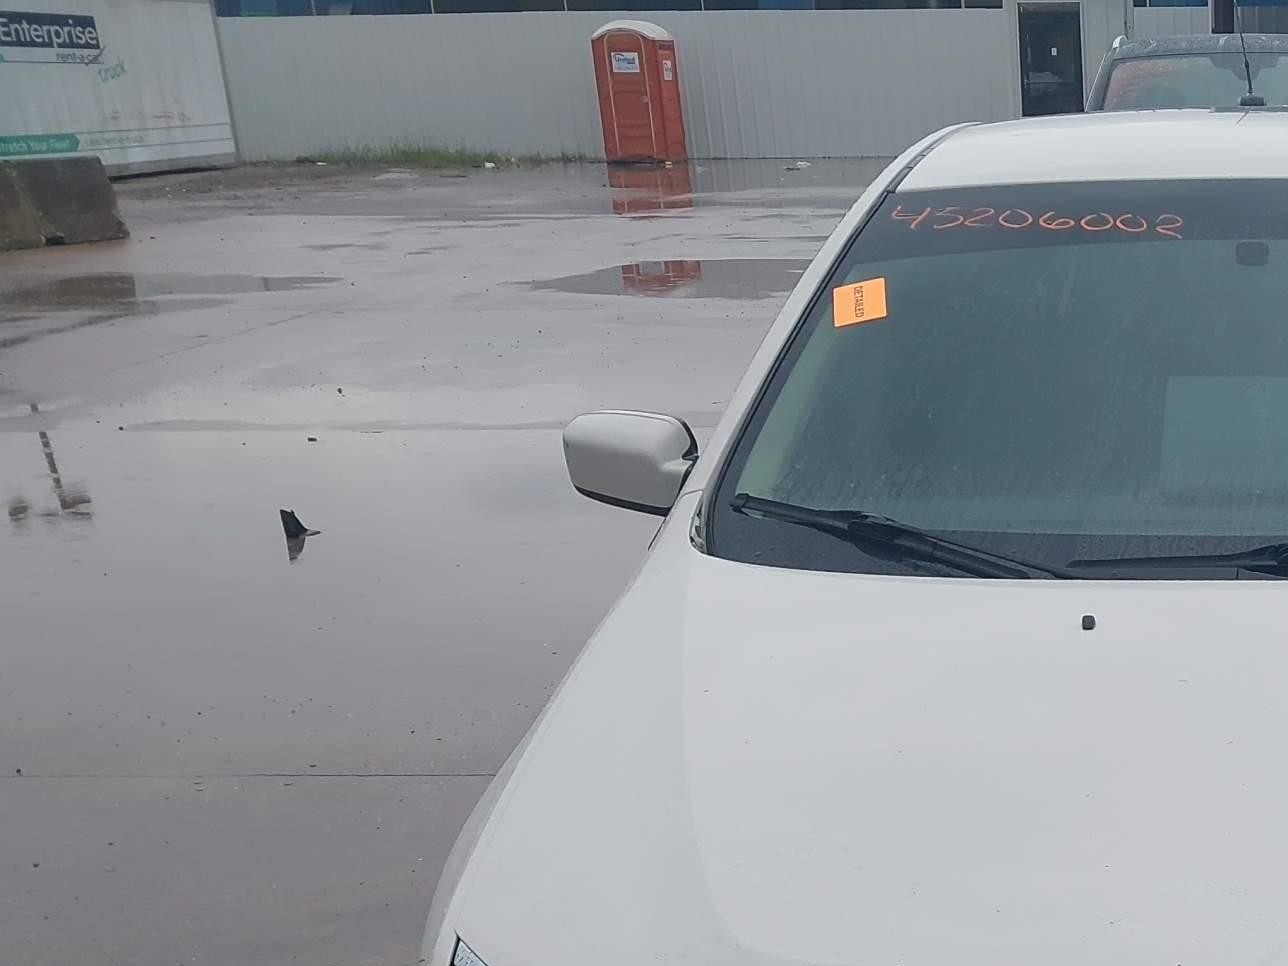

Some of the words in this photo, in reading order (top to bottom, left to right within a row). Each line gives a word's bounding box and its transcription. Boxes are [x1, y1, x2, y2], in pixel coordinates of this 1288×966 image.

[0, 17, 98, 48] Enterprise
[891, 205, 1183, 239] 45206002
[853, 285, 865, 318] DETAILED
